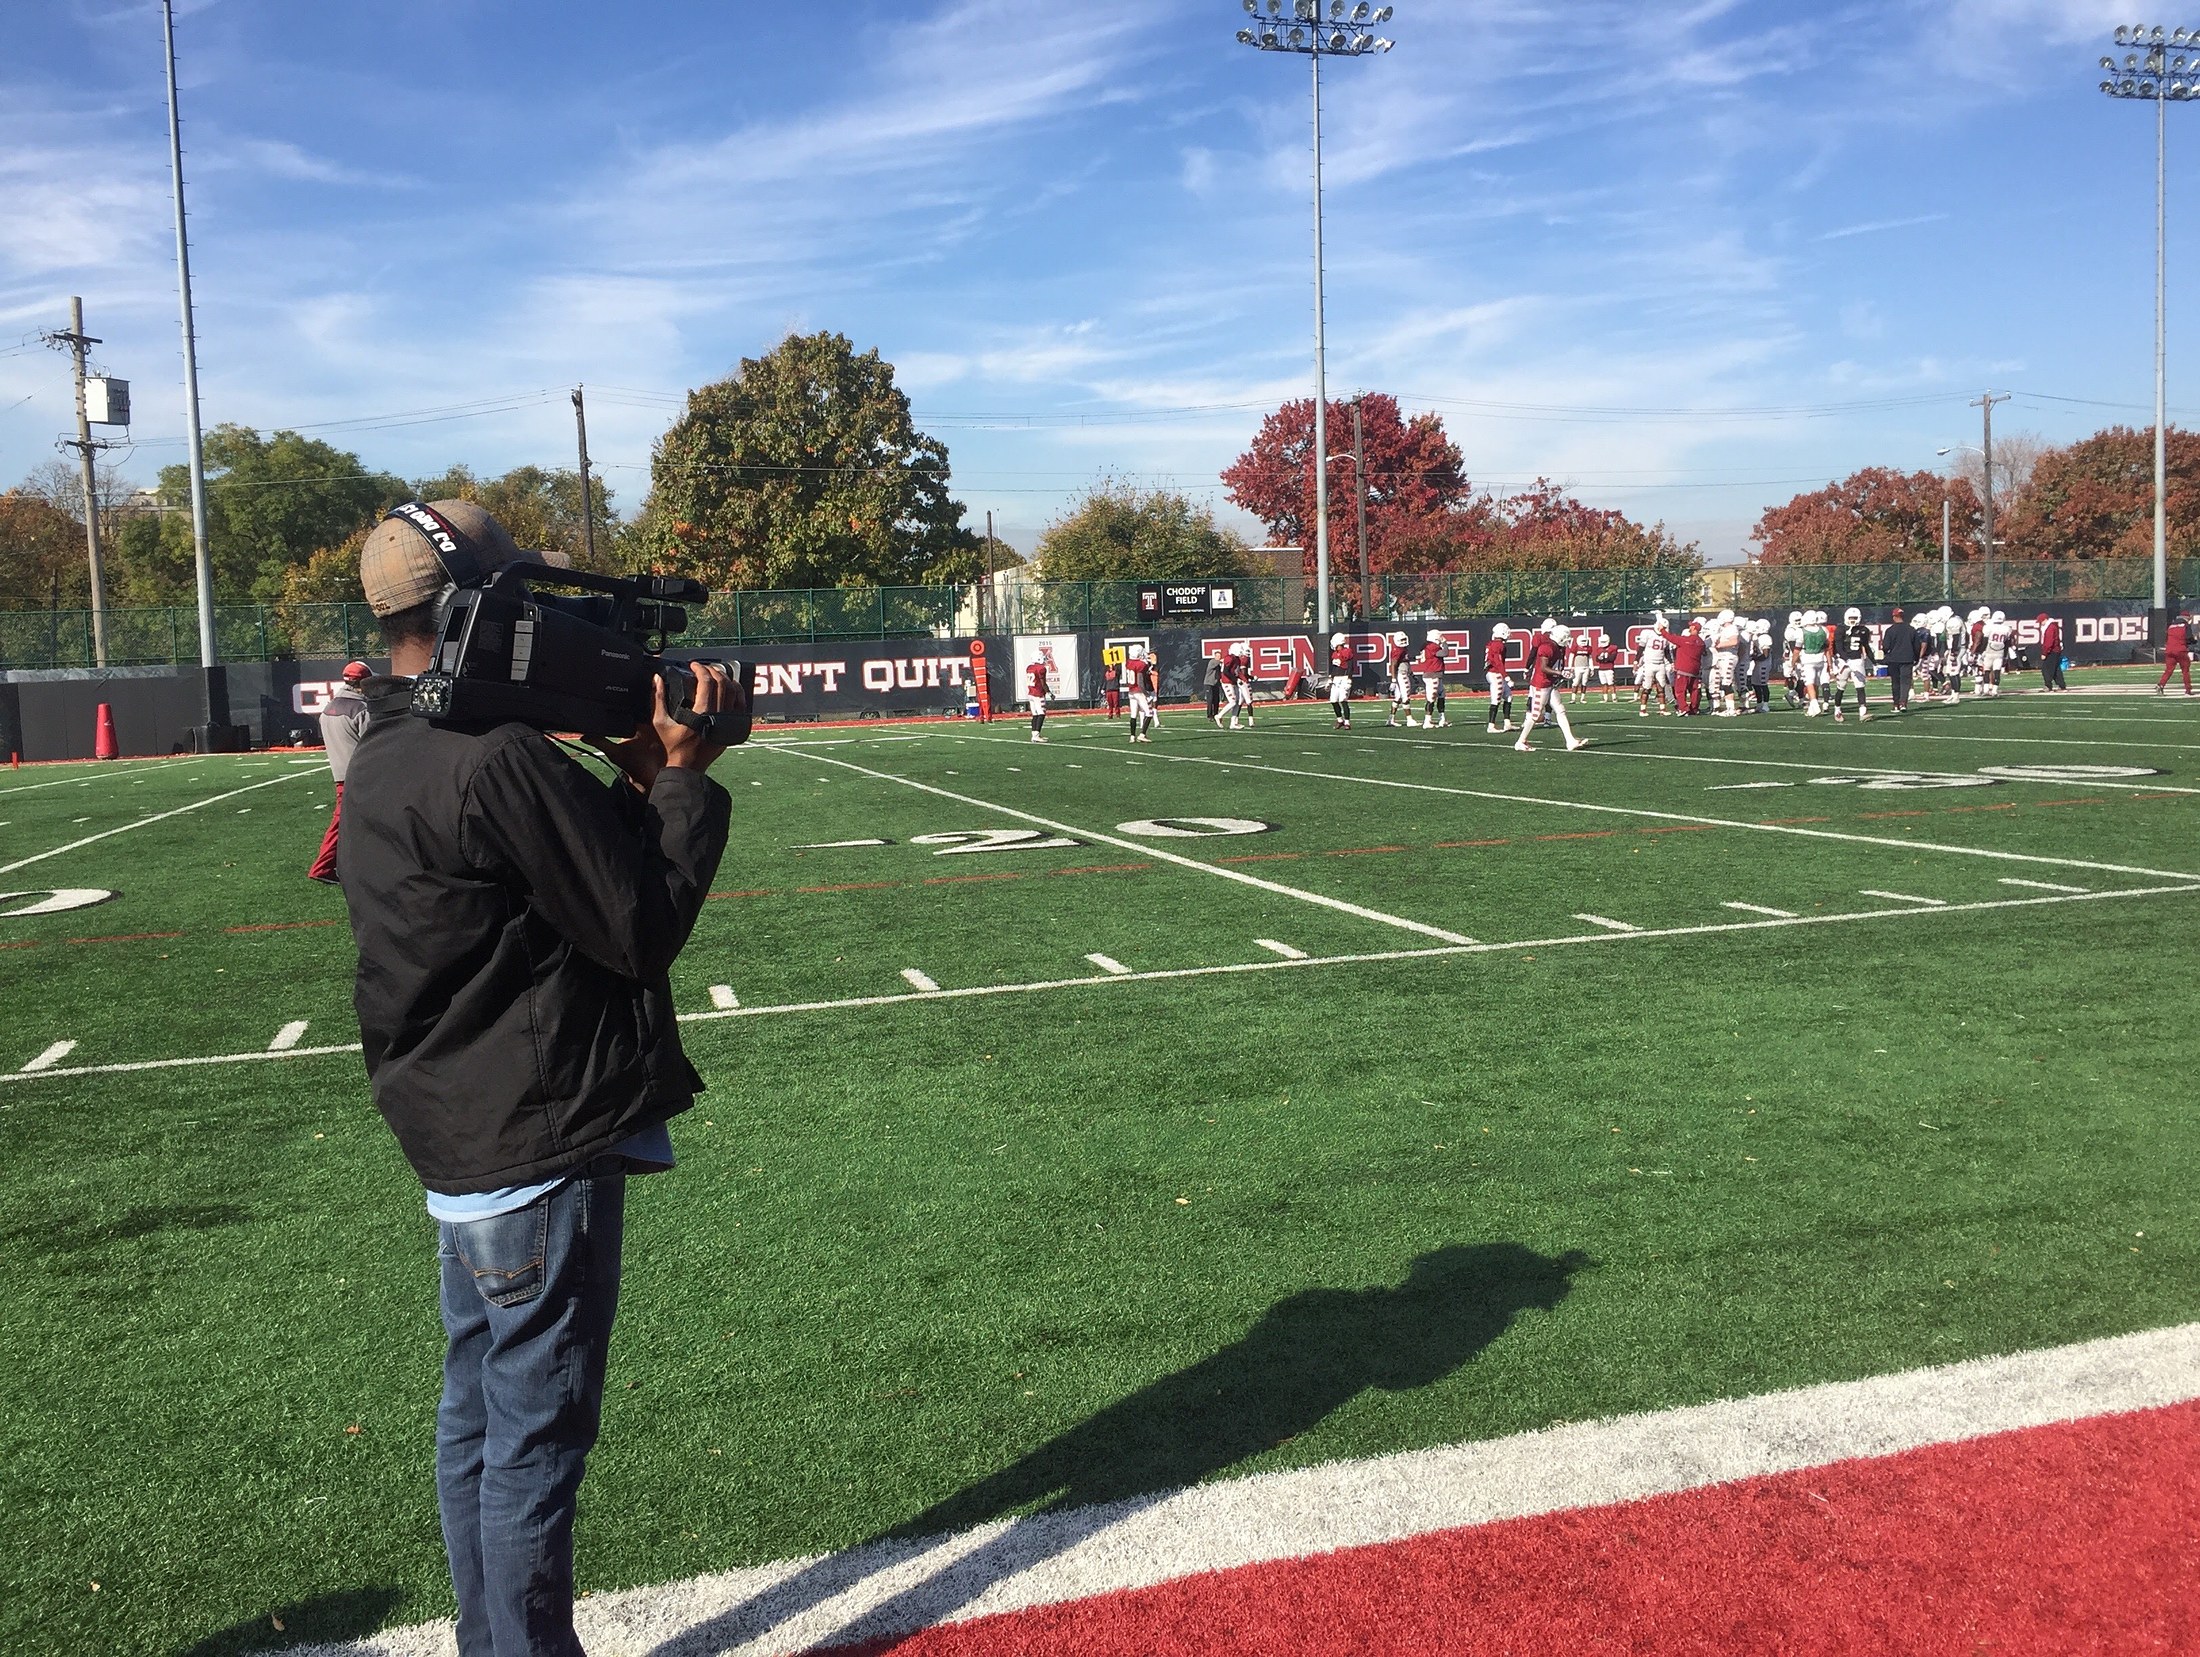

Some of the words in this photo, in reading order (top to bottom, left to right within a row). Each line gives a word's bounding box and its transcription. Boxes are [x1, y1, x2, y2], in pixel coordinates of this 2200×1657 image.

[1166, 587, 1206, 596] CHODOFF
[1175, 596, 1198, 605] FIELD
[2075, 616, 2149, 643] DOE
[1491, 625, 1656, 673] OLS
[1651, 639, 1664, 650] 61
[601, 648, 631, 660] Panasonic
[1108, 650, 1120, 662] 11
[1201, 629, 1470, 682] TEMPLE
[754, 661, 846, 696] SN'T
[862, 656, 971, 693] QUIT
